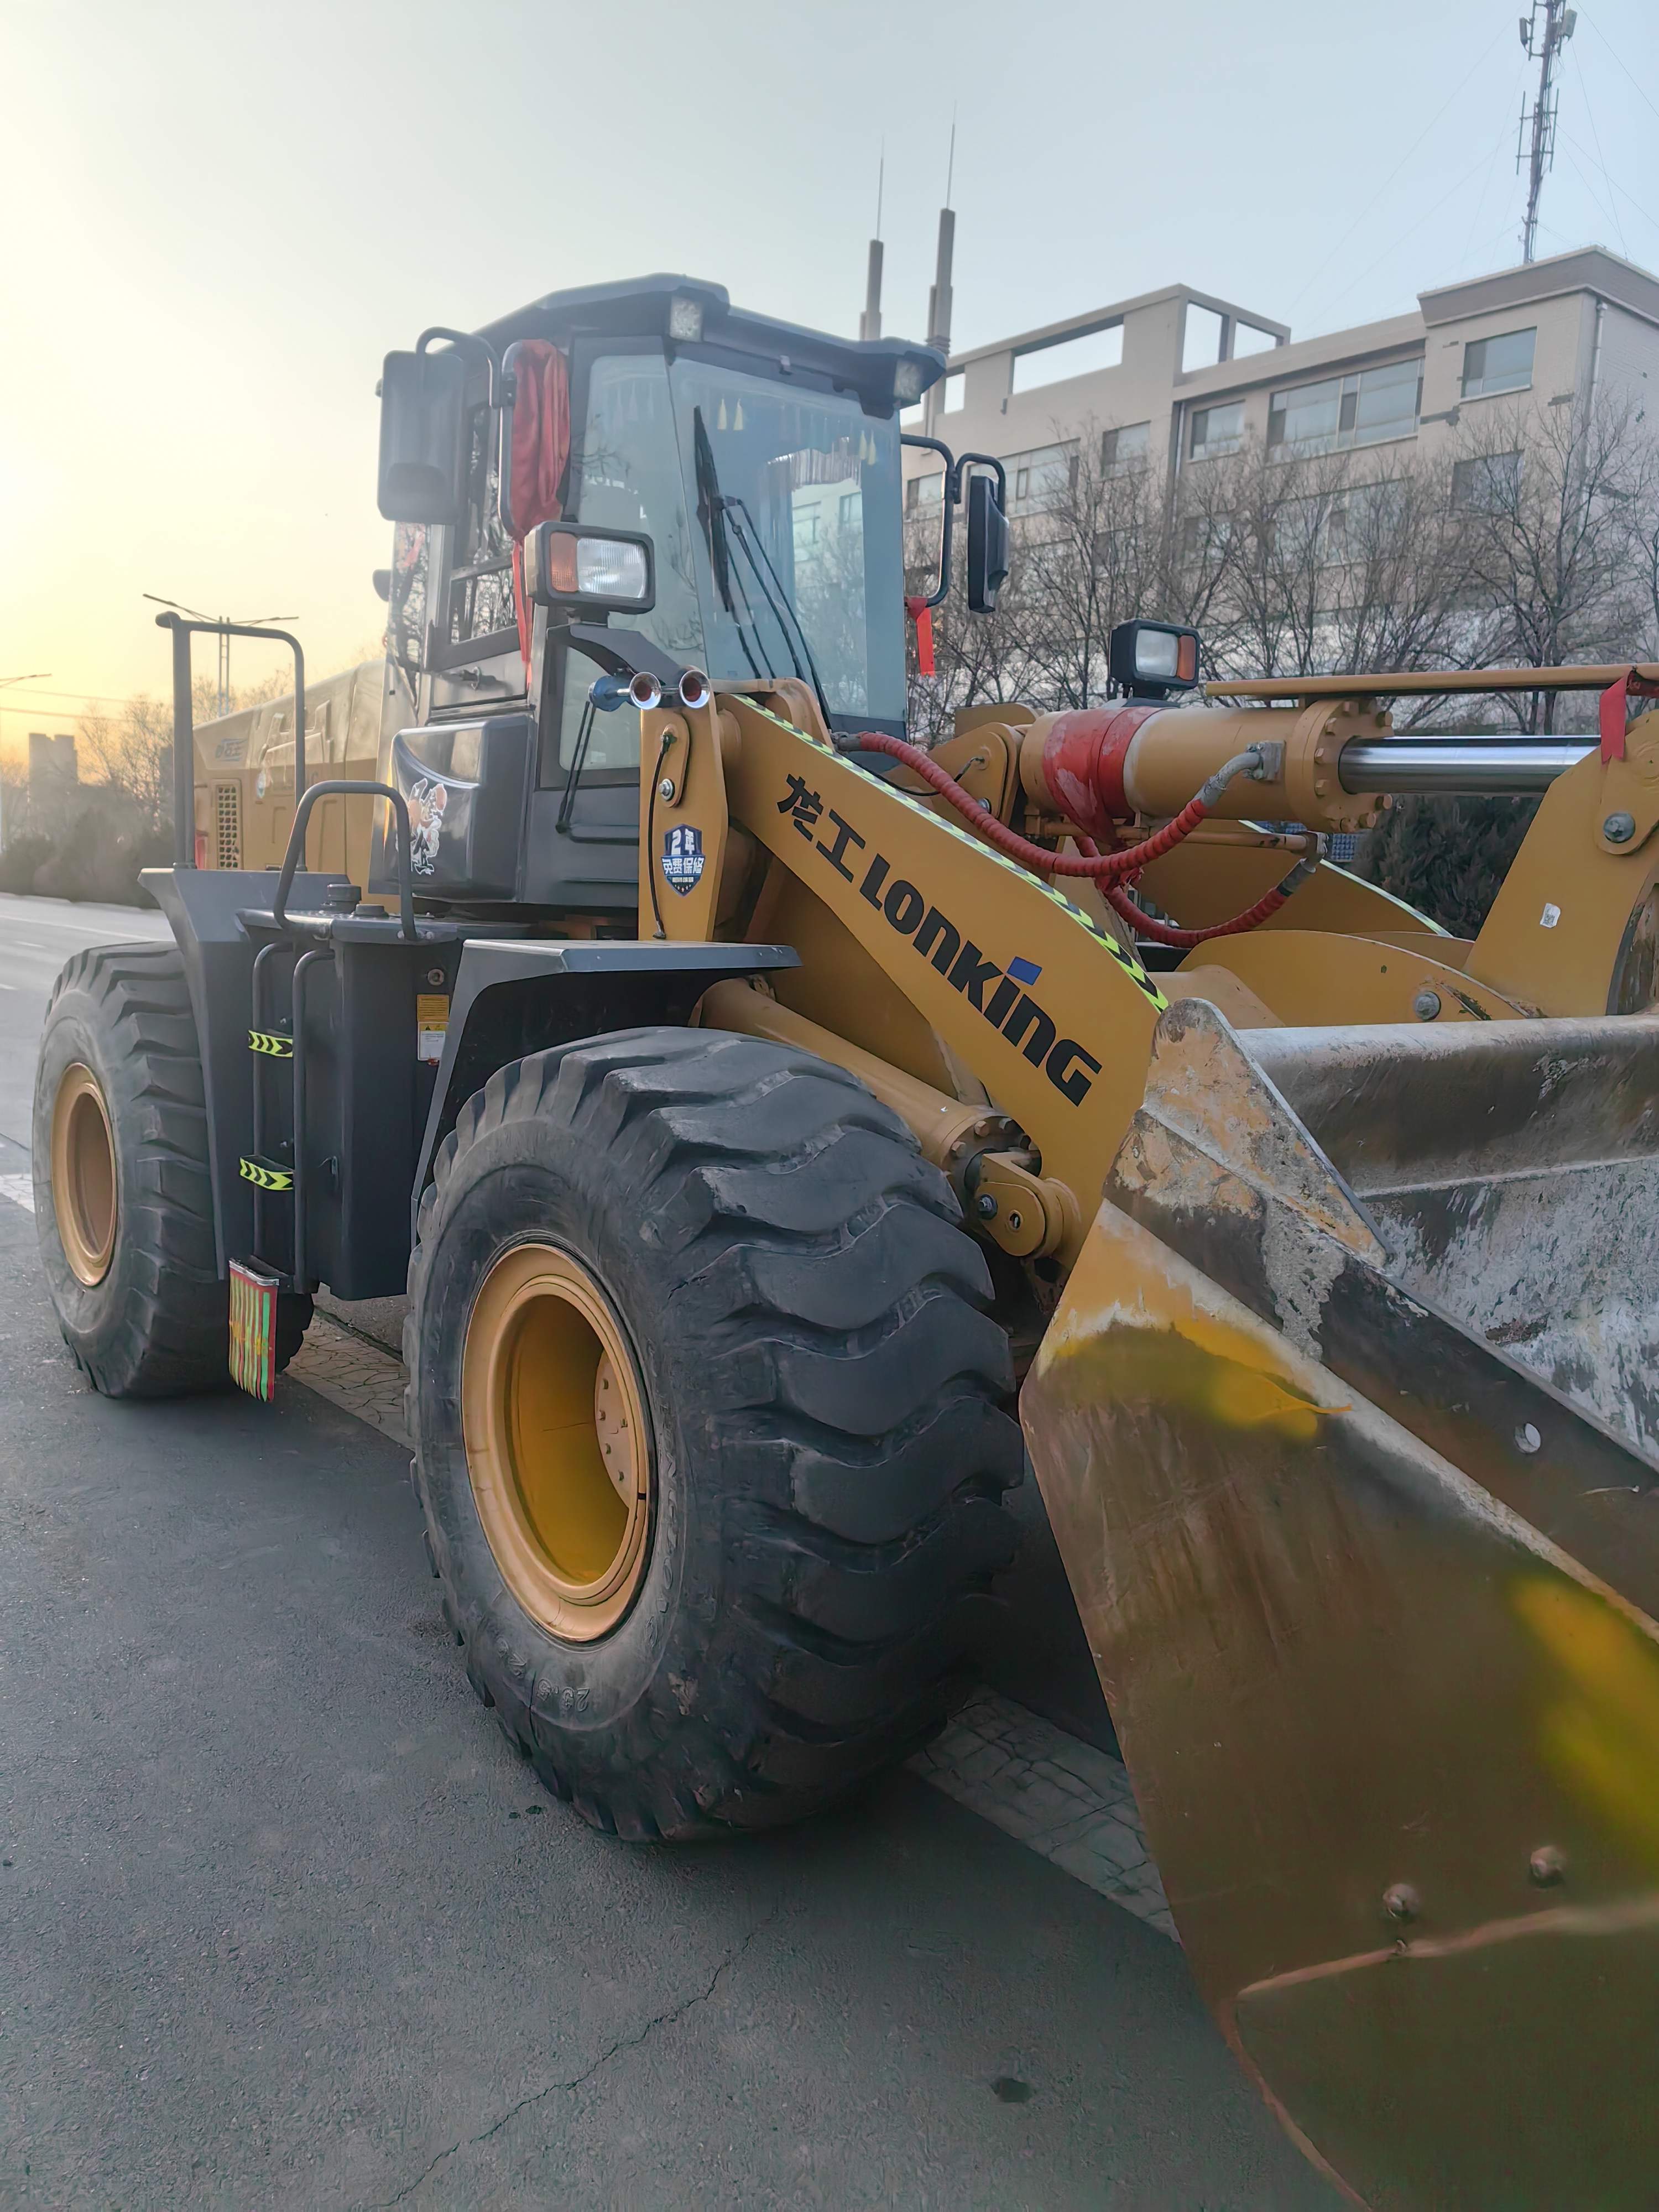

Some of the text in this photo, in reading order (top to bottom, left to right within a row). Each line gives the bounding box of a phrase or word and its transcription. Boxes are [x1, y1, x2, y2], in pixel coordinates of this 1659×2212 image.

[671, 828, 695, 855] 2年
[776, 773, 867, 883] 龙工
[662, 857, 705, 874] 免费保修
